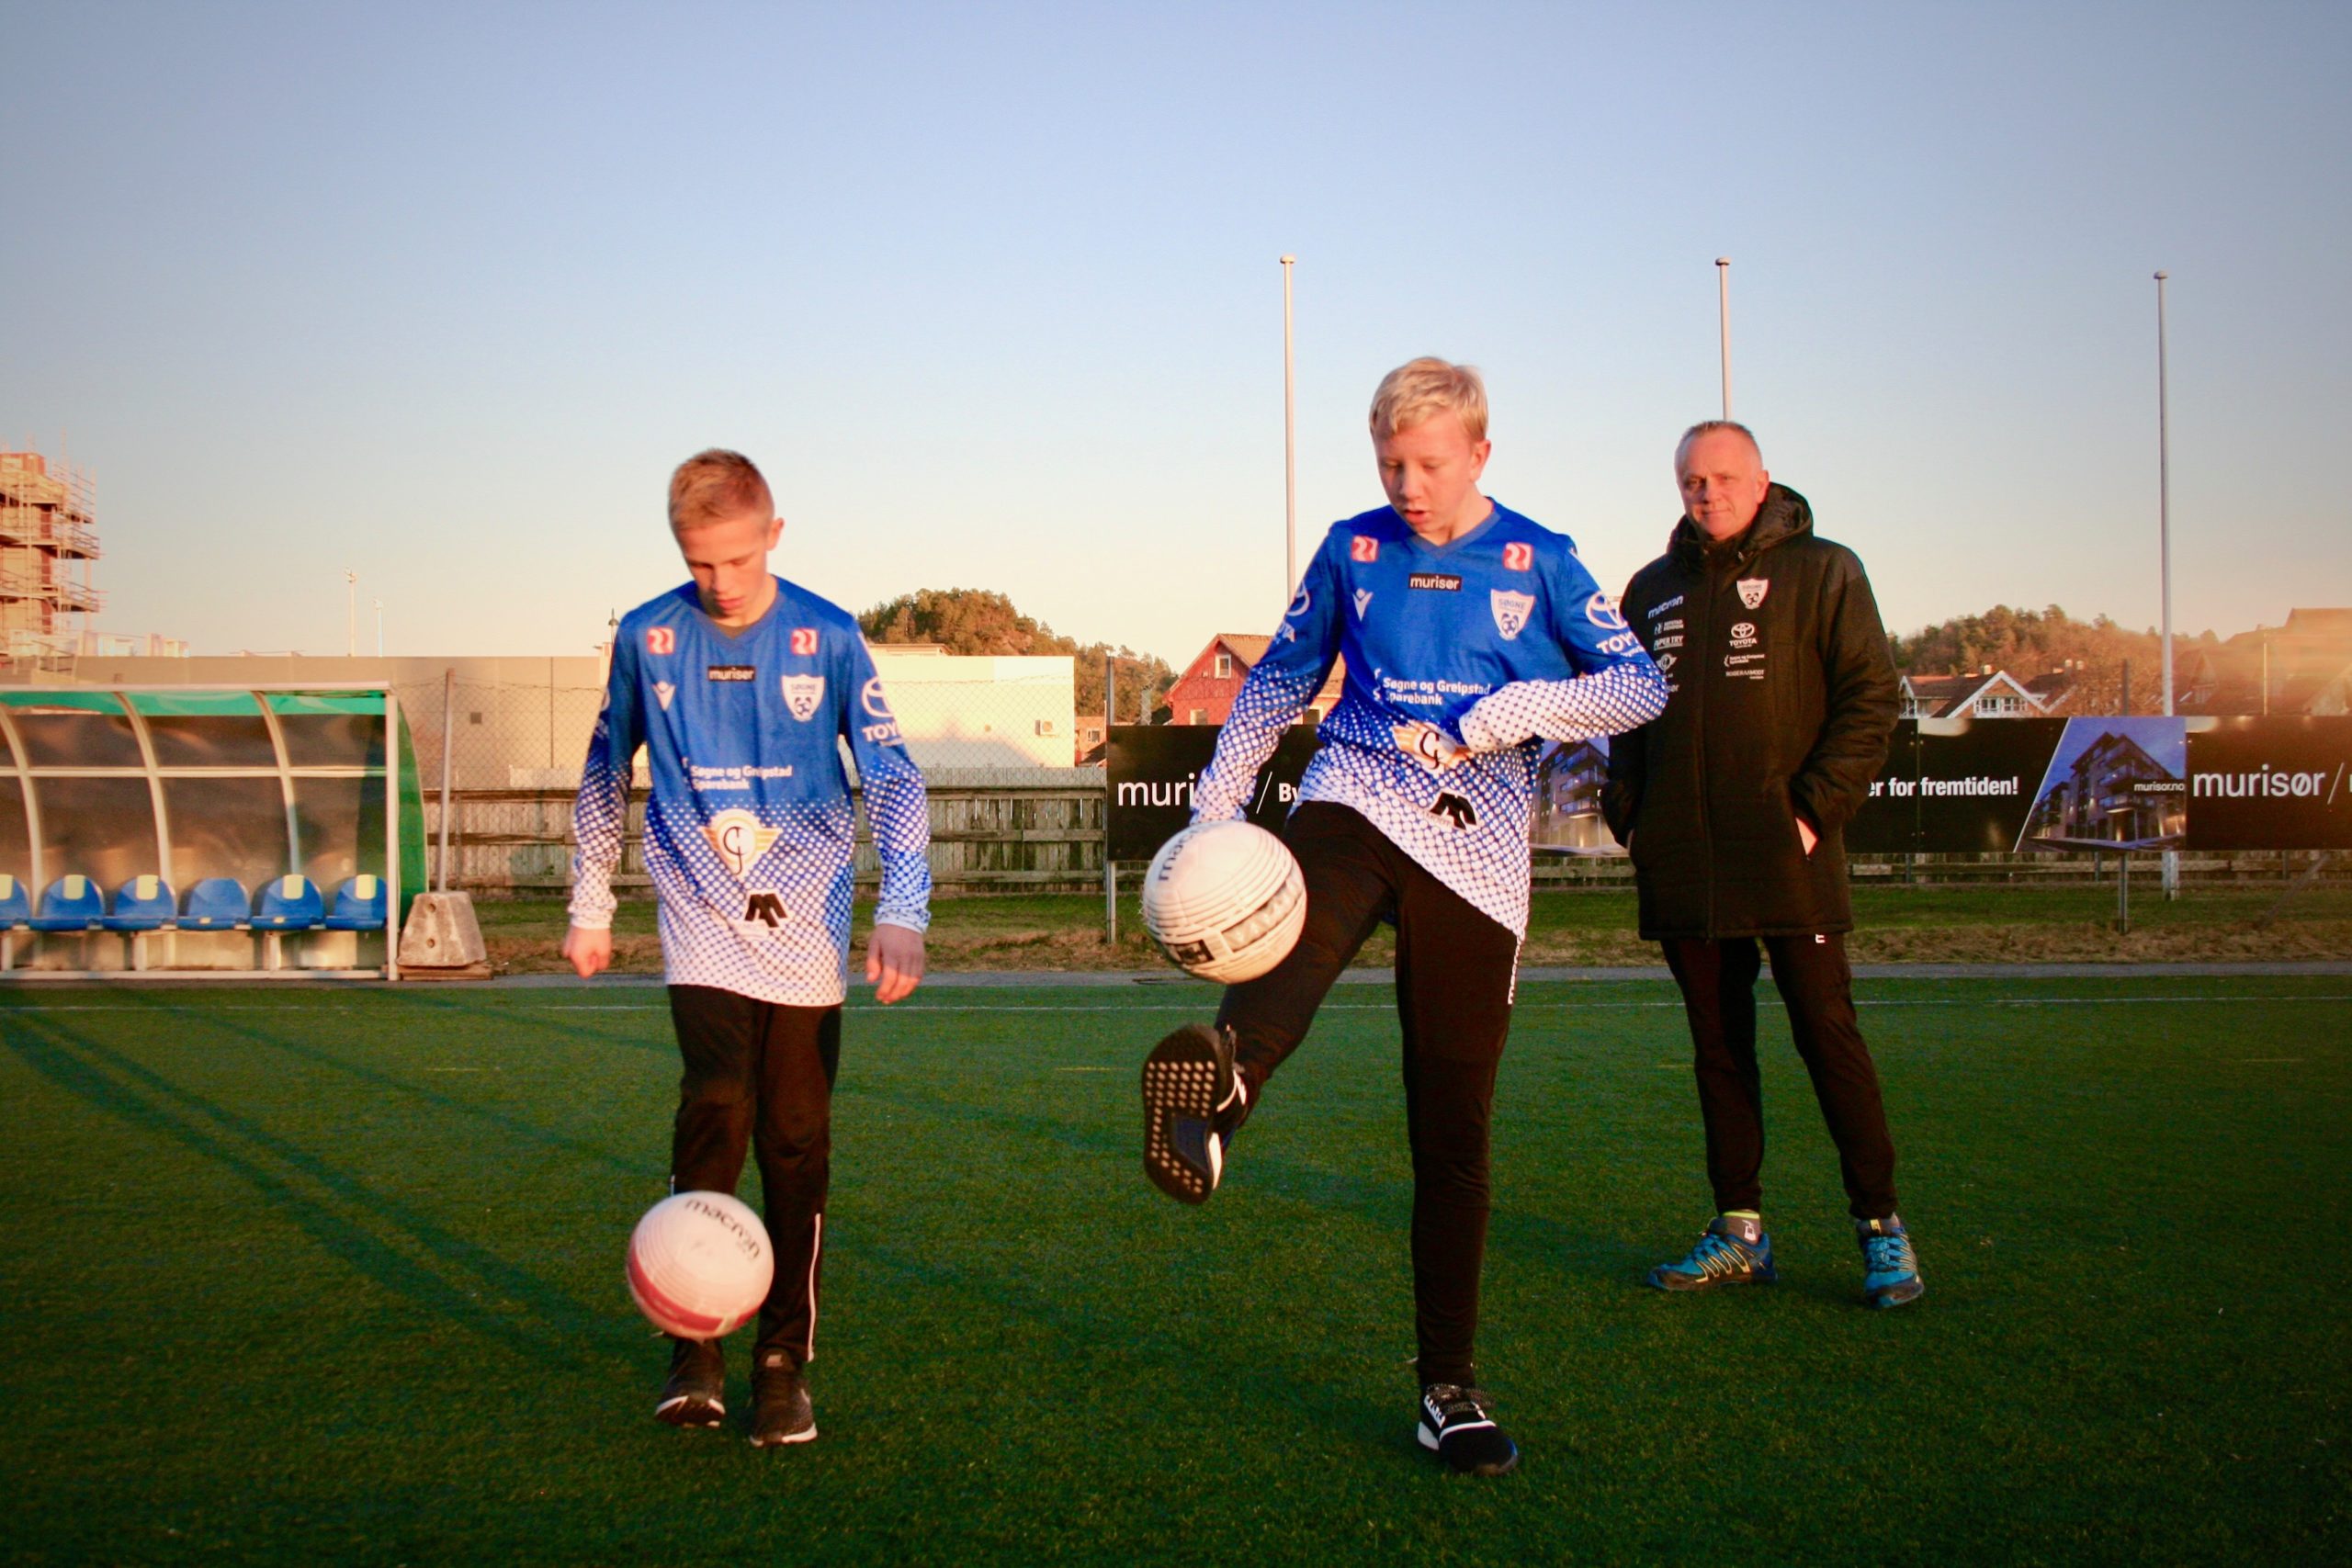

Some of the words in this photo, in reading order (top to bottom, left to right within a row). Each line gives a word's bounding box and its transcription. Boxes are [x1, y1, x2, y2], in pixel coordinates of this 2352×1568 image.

[1596, 631, 1637, 655] TOY
[1729, 637, 1758, 647] TOYOTA
[1383, 677, 1418, 691] Søgne
[1419, 681, 1434, 693] og
[1437, 680, 1491, 695] Greipstad
[1386, 691, 1443, 705] parebank
[862, 721, 900, 742] TOY
[1117, 772, 1195, 806] muri
[1278, 783, 1300, 803] By
[1888, 777, 1917, 796] for
[1920, 776, 2018, 796] fremtiden!
[2193, 763, 2325, 797] murisør
